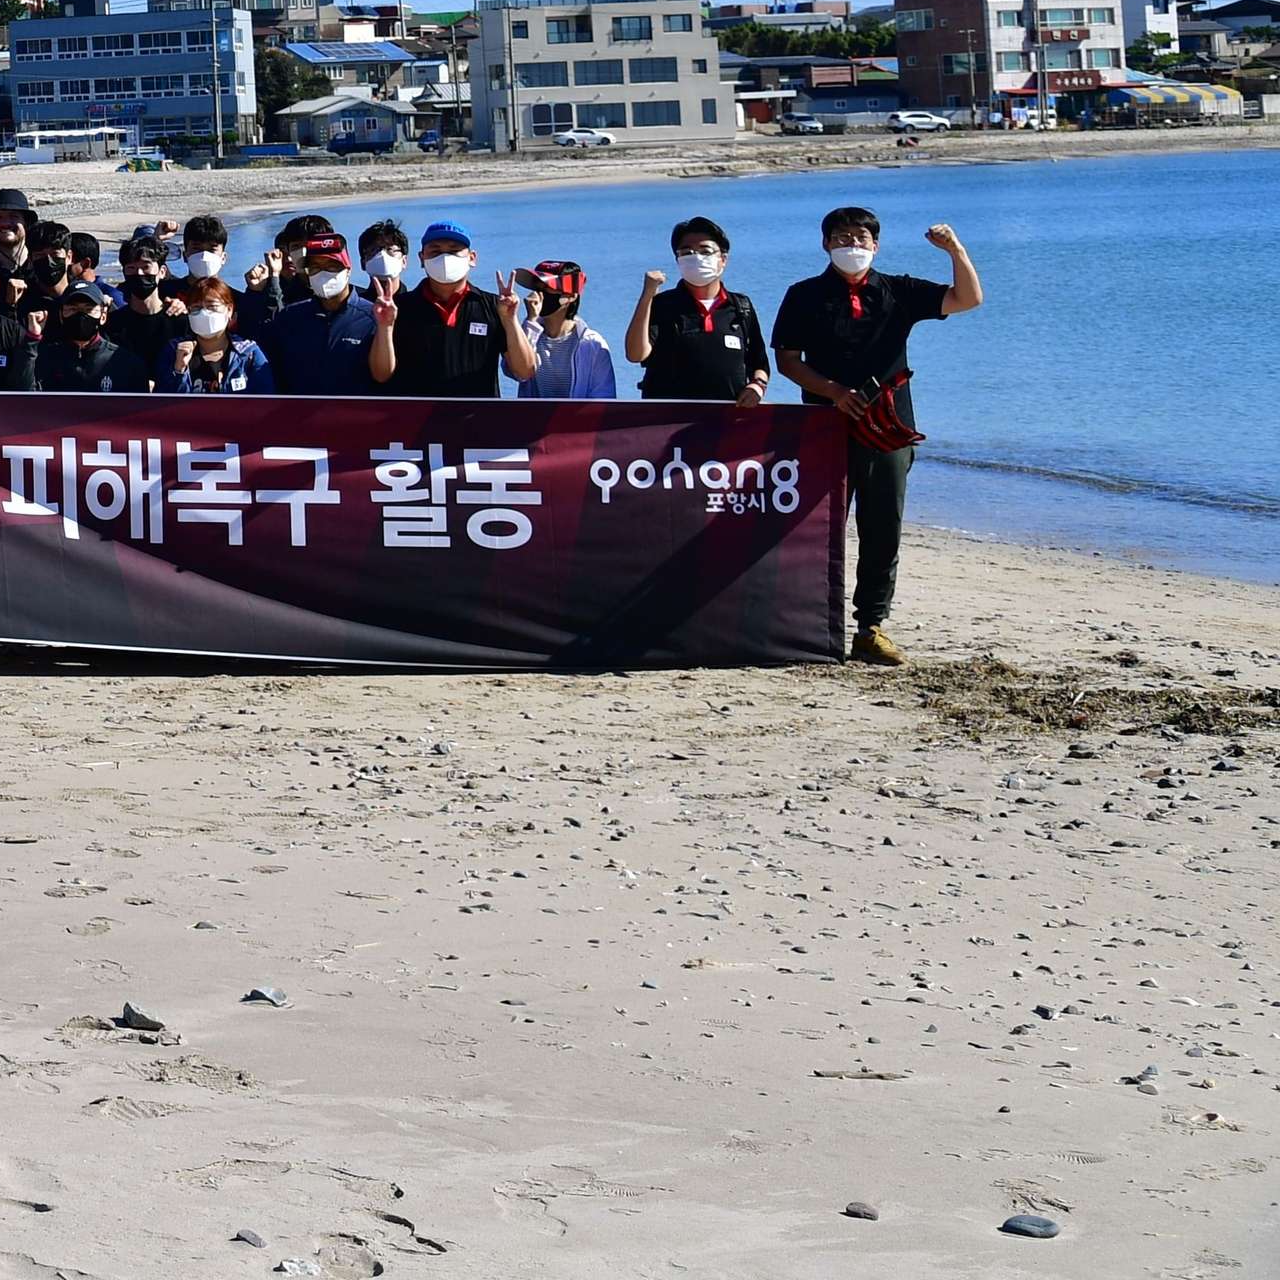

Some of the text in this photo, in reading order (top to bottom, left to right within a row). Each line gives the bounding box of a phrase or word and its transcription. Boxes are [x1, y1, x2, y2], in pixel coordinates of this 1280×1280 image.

[0, 437, 341, 548] 피해복구
[369, 442, 542, 550] 활동
[589, 447, 800, 514] pohang
[705, 491, 766, 514] 포항시
